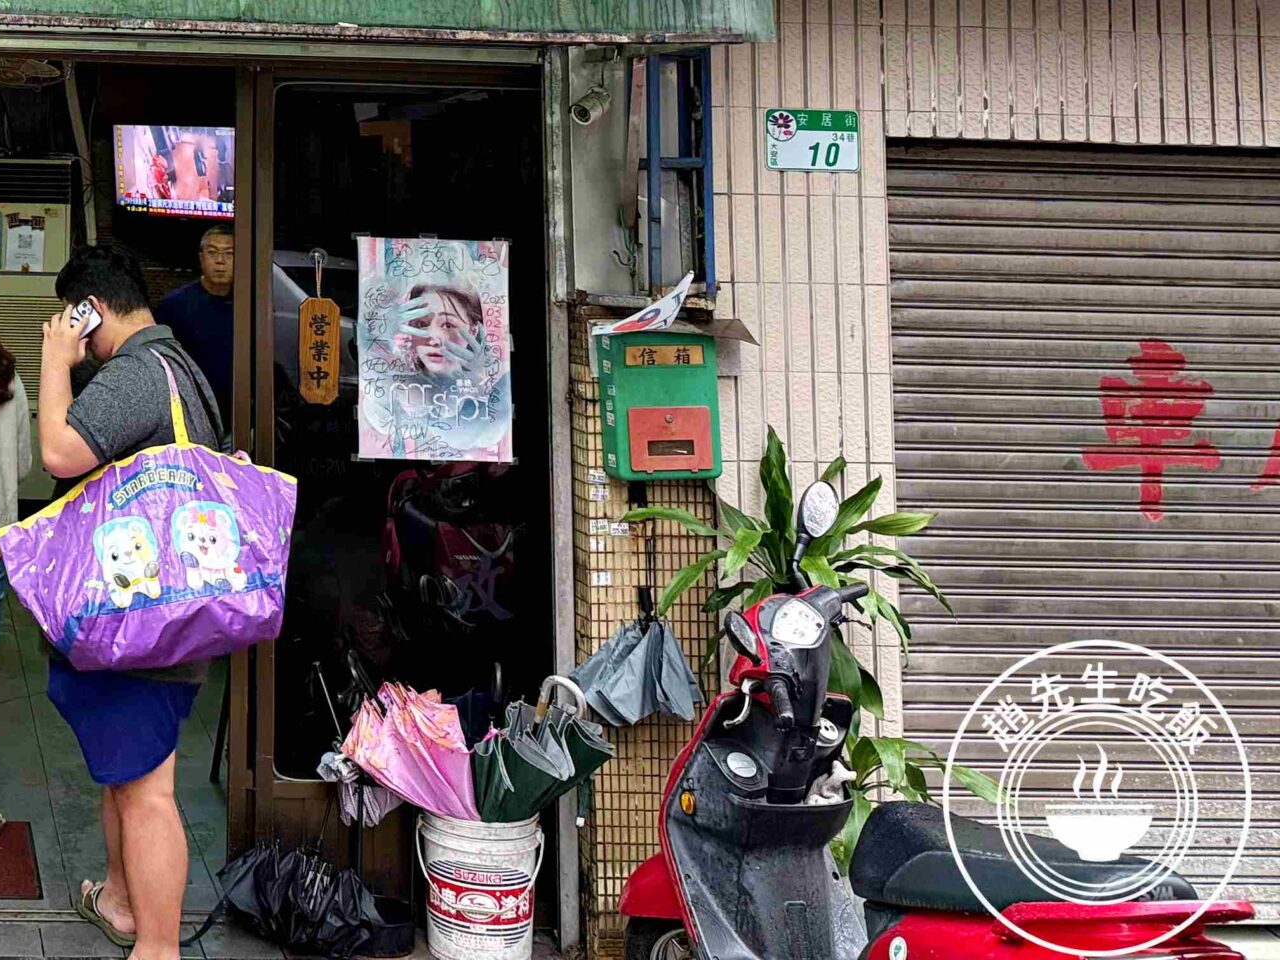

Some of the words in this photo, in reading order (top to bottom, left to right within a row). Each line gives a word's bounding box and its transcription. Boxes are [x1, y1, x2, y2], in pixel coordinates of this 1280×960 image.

[797, 112, 856, 128] 安居街
[808, 141, 840, 167] 10
[307, 313, 331, 390] 營業中
[638, 347, 691, 366] 信箱
